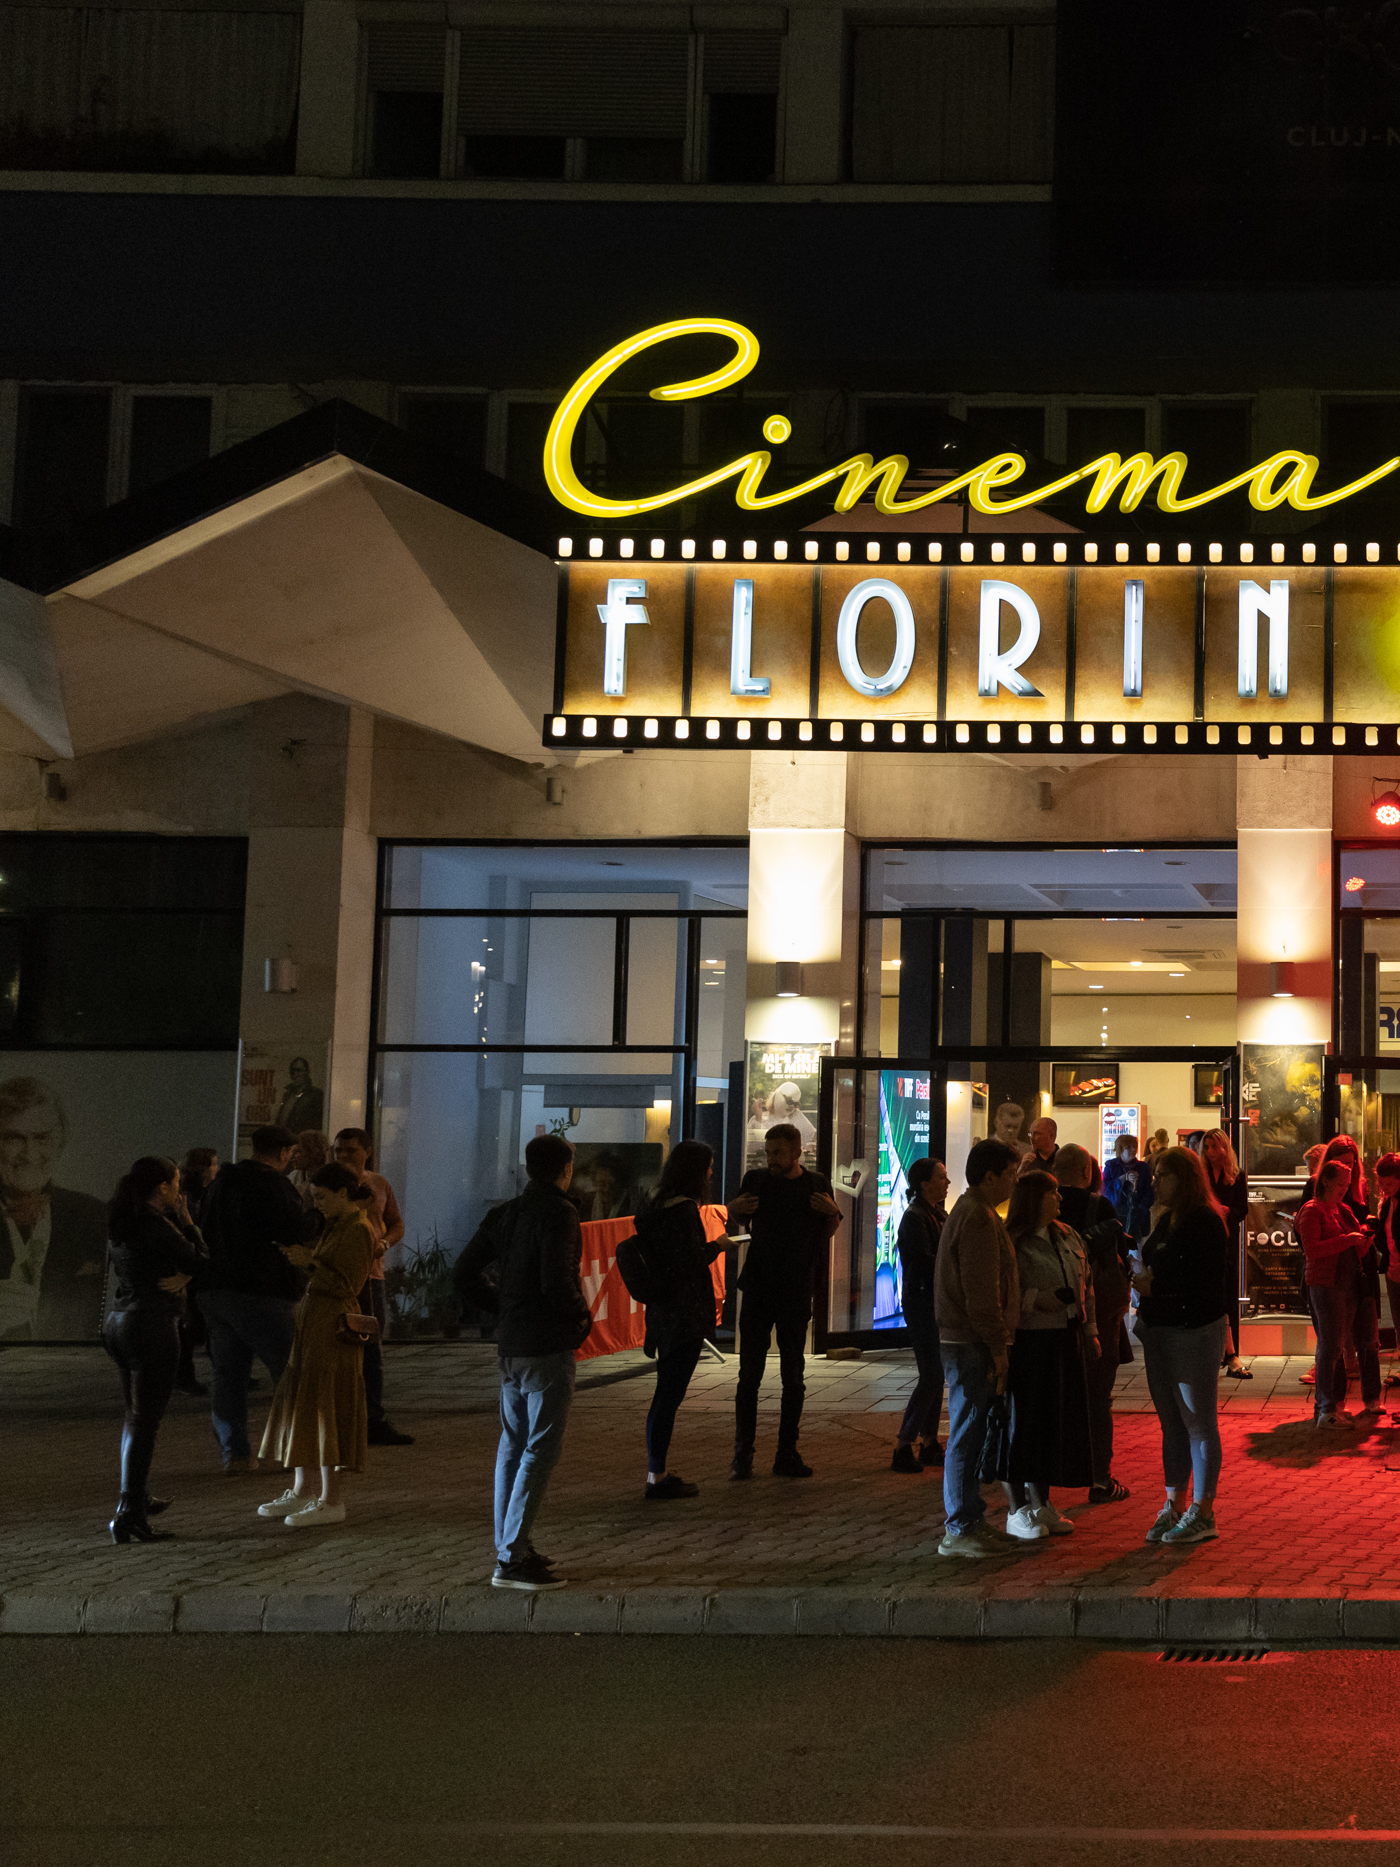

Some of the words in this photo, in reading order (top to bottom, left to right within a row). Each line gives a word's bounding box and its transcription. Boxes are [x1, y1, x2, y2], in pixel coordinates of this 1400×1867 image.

[596, 577, 1290, 699] FLORIN
[765, 1063, 783, 1074] DE
[1246, 1230, 1299, 1247] FOCU
